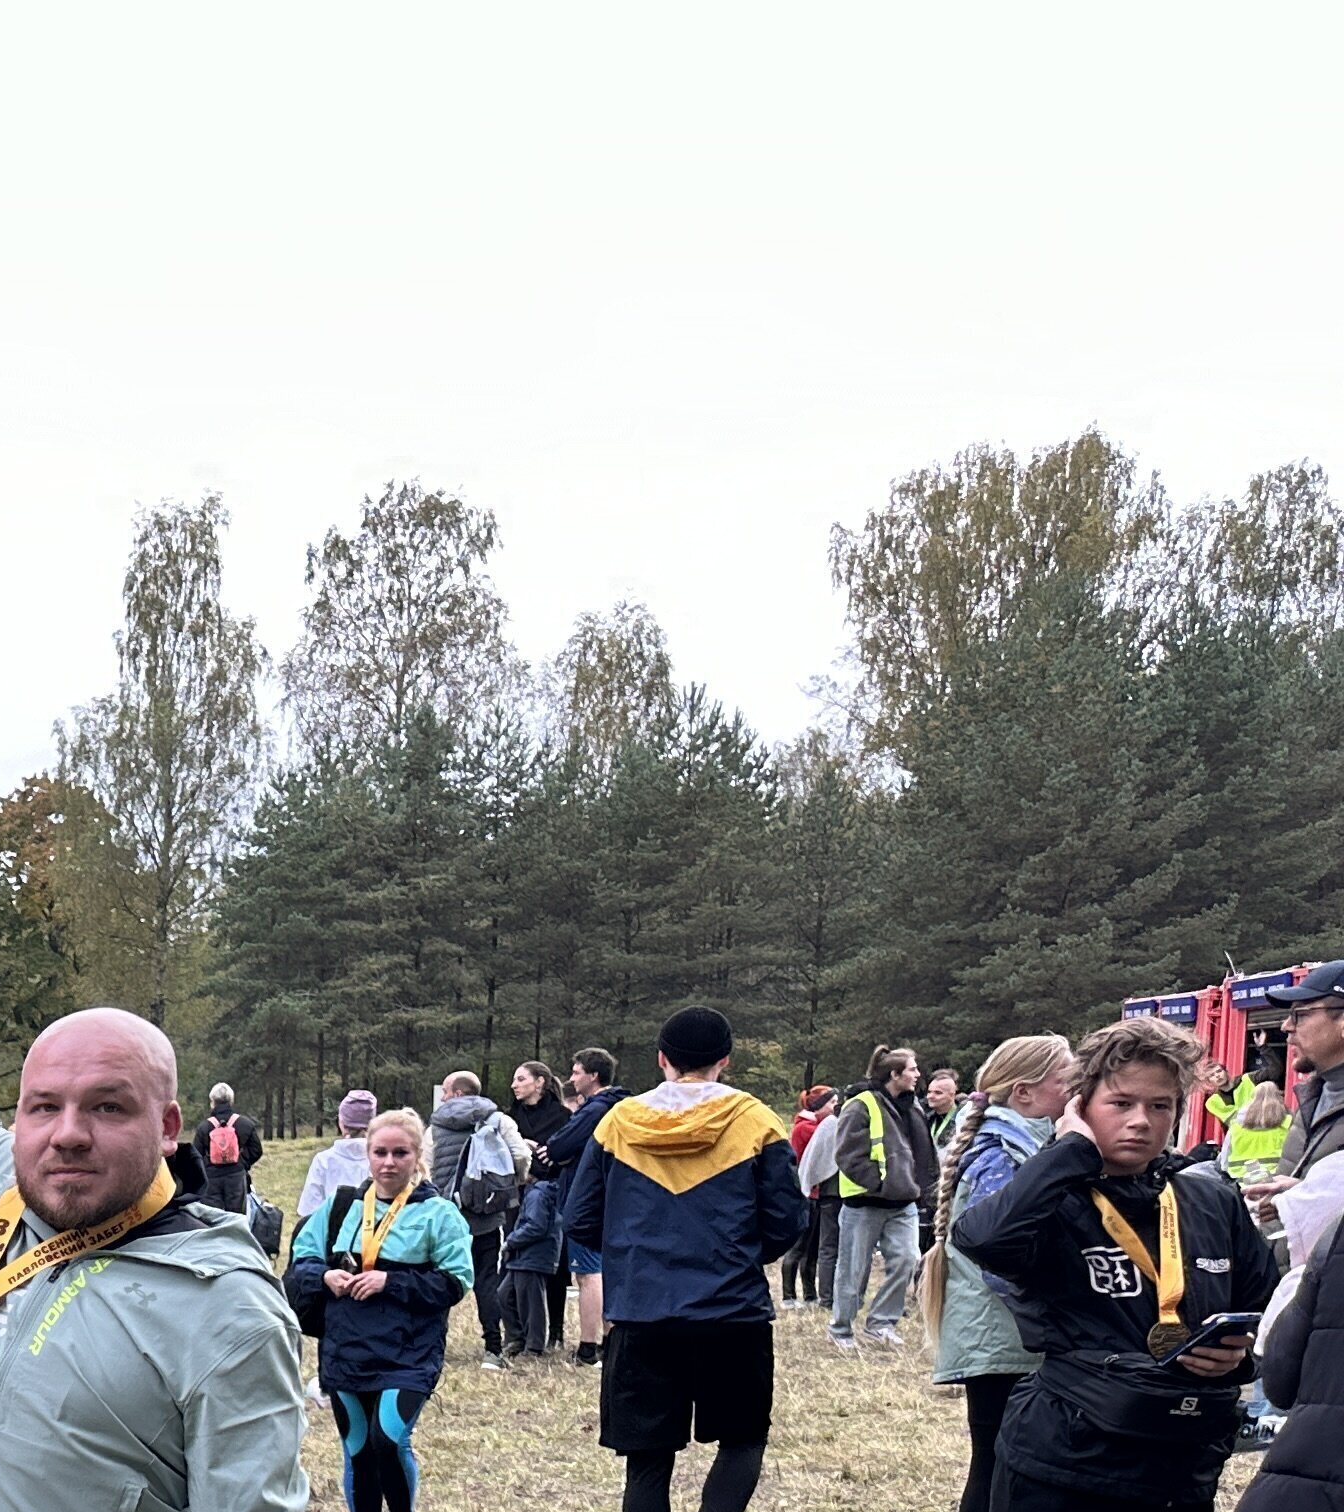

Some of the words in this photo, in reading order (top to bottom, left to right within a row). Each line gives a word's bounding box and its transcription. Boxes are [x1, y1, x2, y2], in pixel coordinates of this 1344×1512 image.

[8, 1239, 87, 1285] ПАВЛОВСКИЙ
[90, 1222, 125, 1246] ЗАБЕГ
[33, 1226, 90, 1258] ОСЕННИЙ
[29, 1269, 87, 1356] ARMOUR
